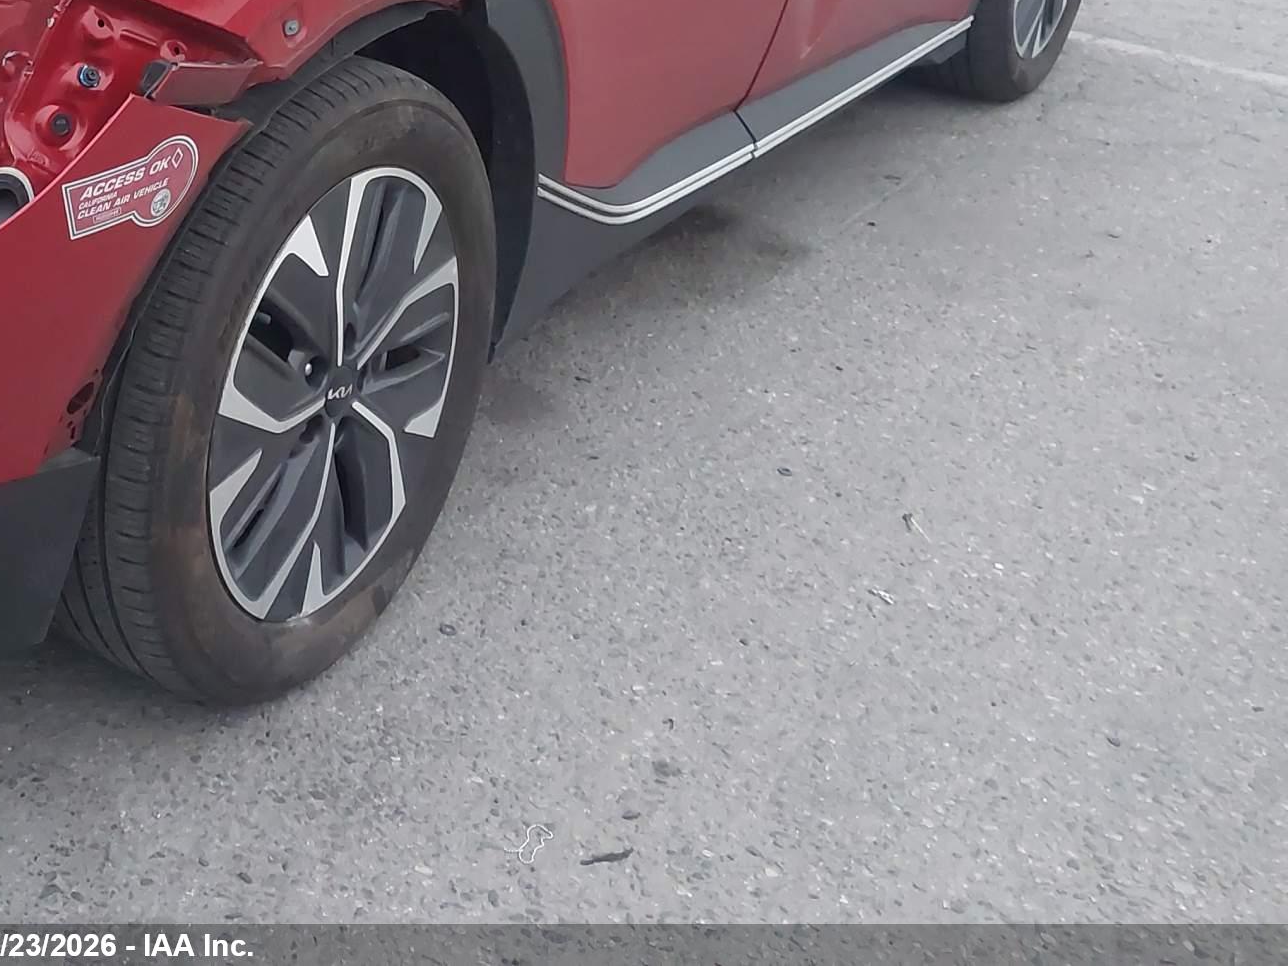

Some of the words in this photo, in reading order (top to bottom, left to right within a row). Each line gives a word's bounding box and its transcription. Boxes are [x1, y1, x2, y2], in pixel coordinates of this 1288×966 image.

[80, 167, 146, 201] ACCESS
[149, 155, 171, 175] OK
[77, 200, 112, 220] CLEAN
[113, 194, 131, 208] AIR
[133, 177, 169, 199] VEHICLE
[78, 191, 118, 210] CALIFORNIA
[327, 384, 353, 400] KIA
